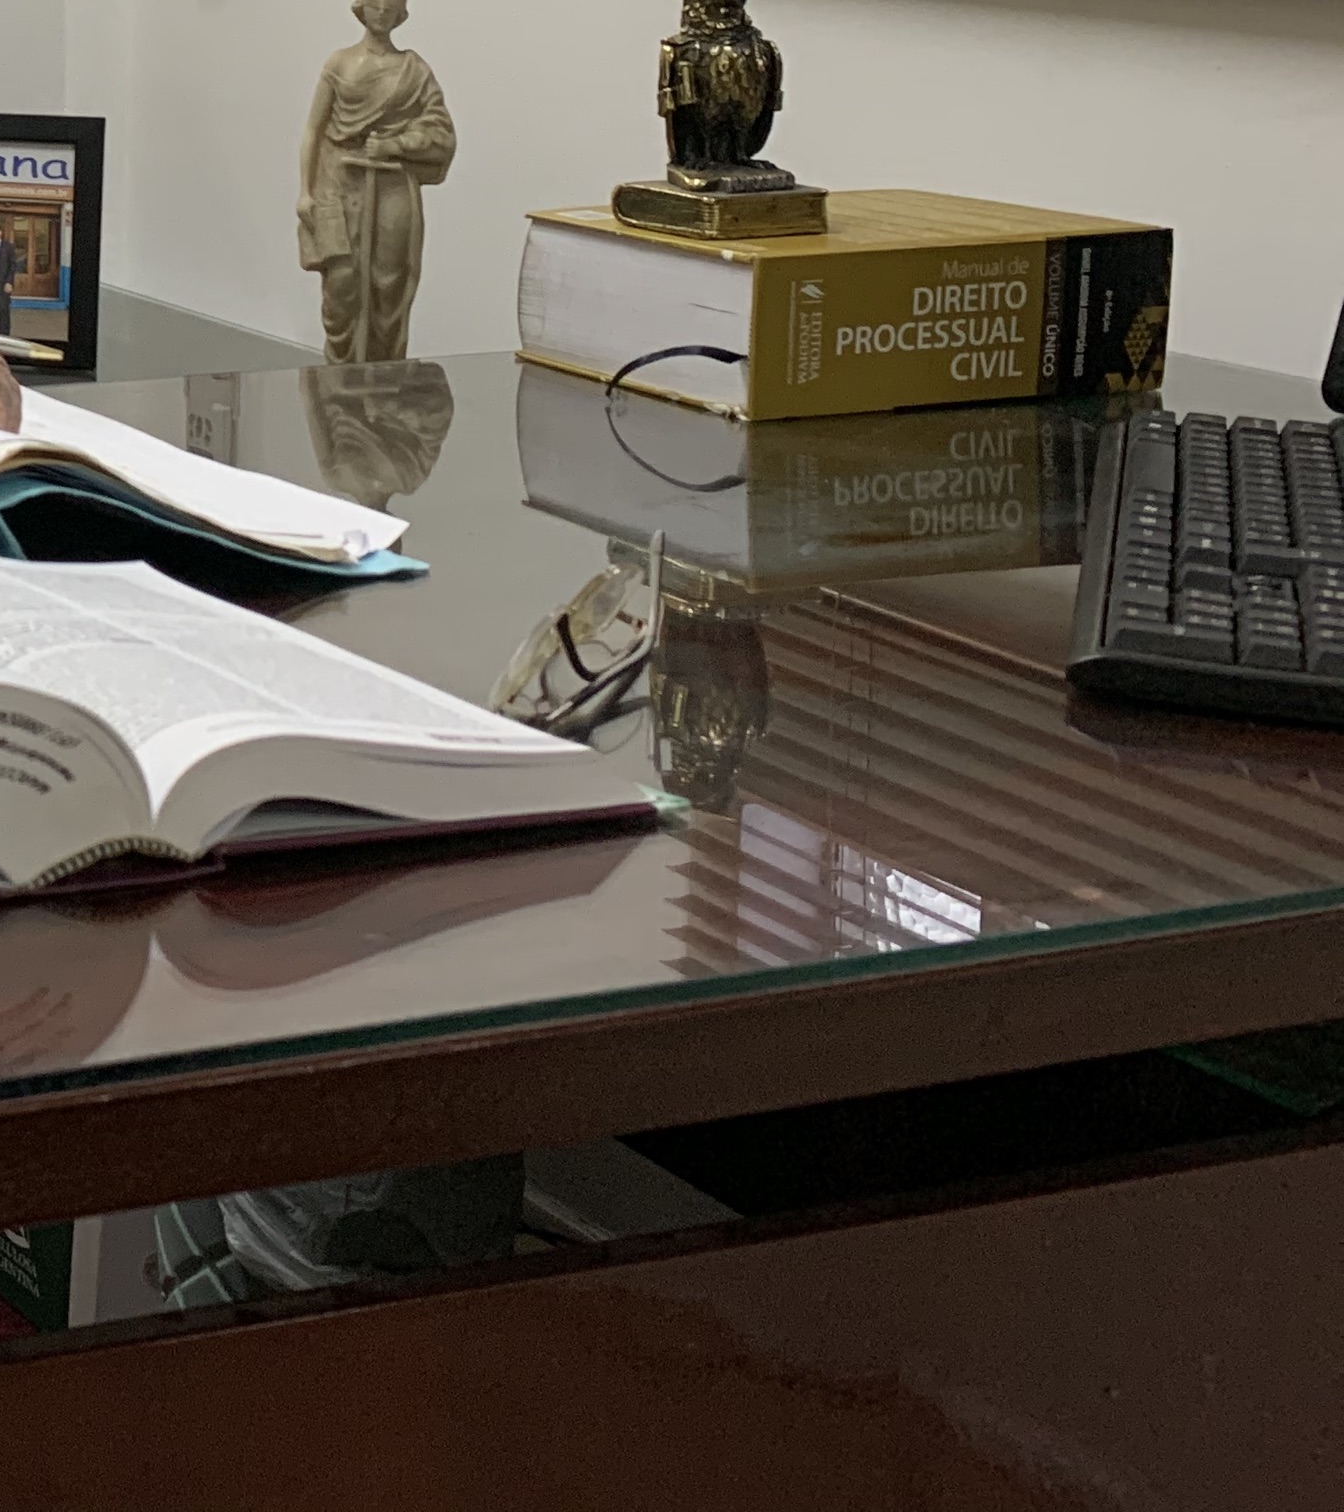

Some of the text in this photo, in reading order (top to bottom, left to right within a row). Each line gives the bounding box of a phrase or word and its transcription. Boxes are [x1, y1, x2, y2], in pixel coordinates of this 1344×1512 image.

[942, 258, 1030, 279] Manual de
[913, 280, 1027, 316] DIREITO
[1042, 254, 1062, 378] VOLUME ÚNICO
[810, 311, 823, 381] EDITORA
[836, 316, 1025, 356] PROCESSUAL
[950, 350, 1022, 382] CIVIL
